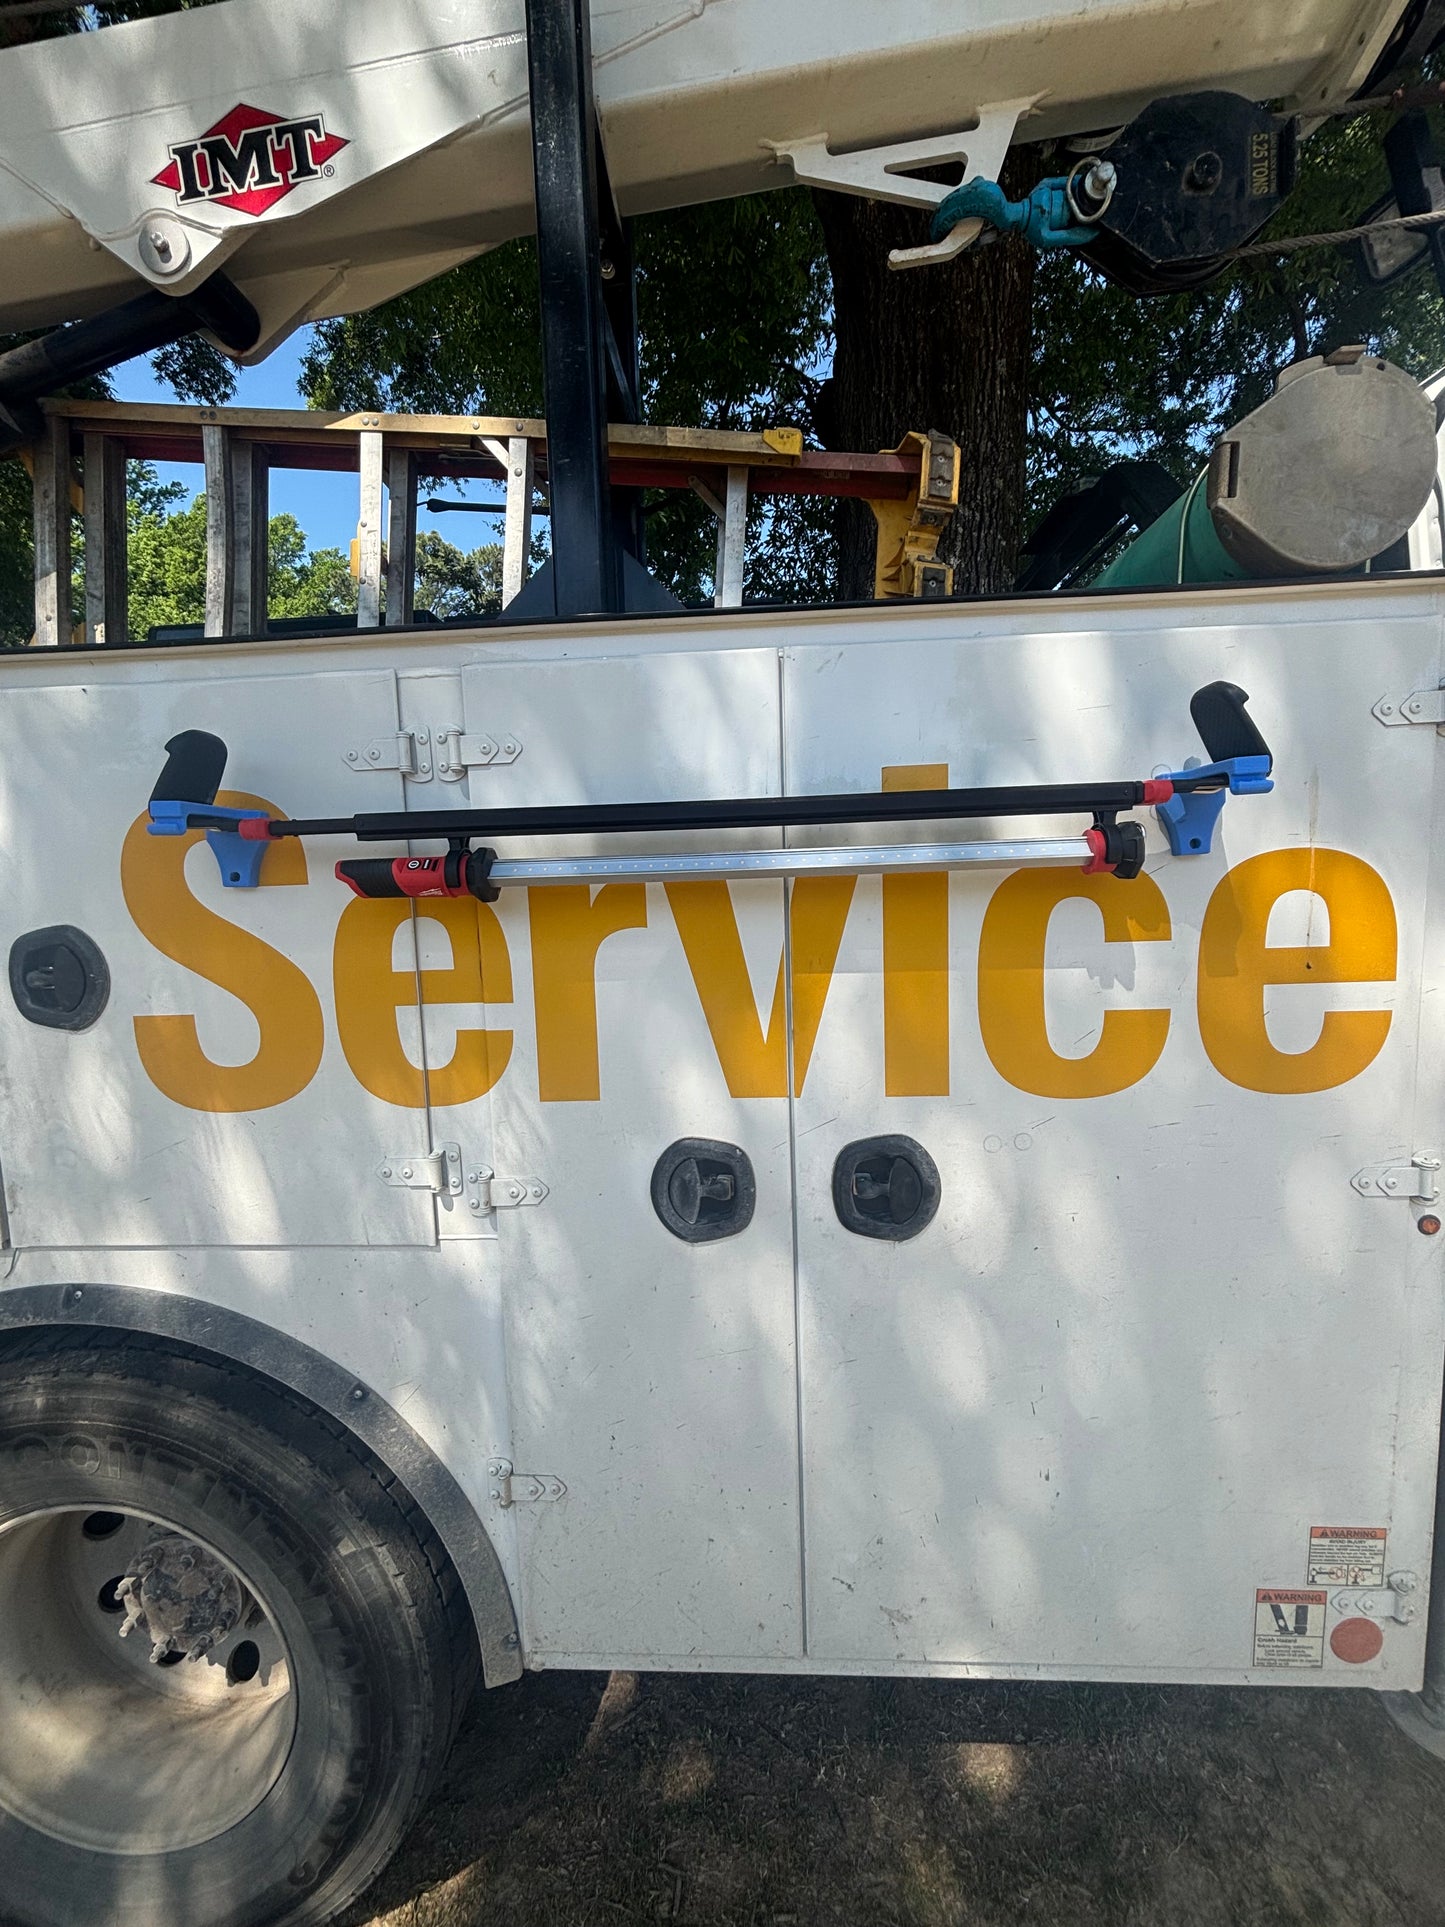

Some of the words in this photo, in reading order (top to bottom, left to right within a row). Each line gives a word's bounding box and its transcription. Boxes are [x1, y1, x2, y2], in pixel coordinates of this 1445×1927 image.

[169, 115, 325, 205] IMT
[1252, 133, 1269, 159] 5.25
[1252, 159, 1269, 195] TONS
[121, 764, 1397, 1113] Service
[1329, 1529, 1377, 1538] WARNING
[1273, 1592, 1322, 1602] WARNING
